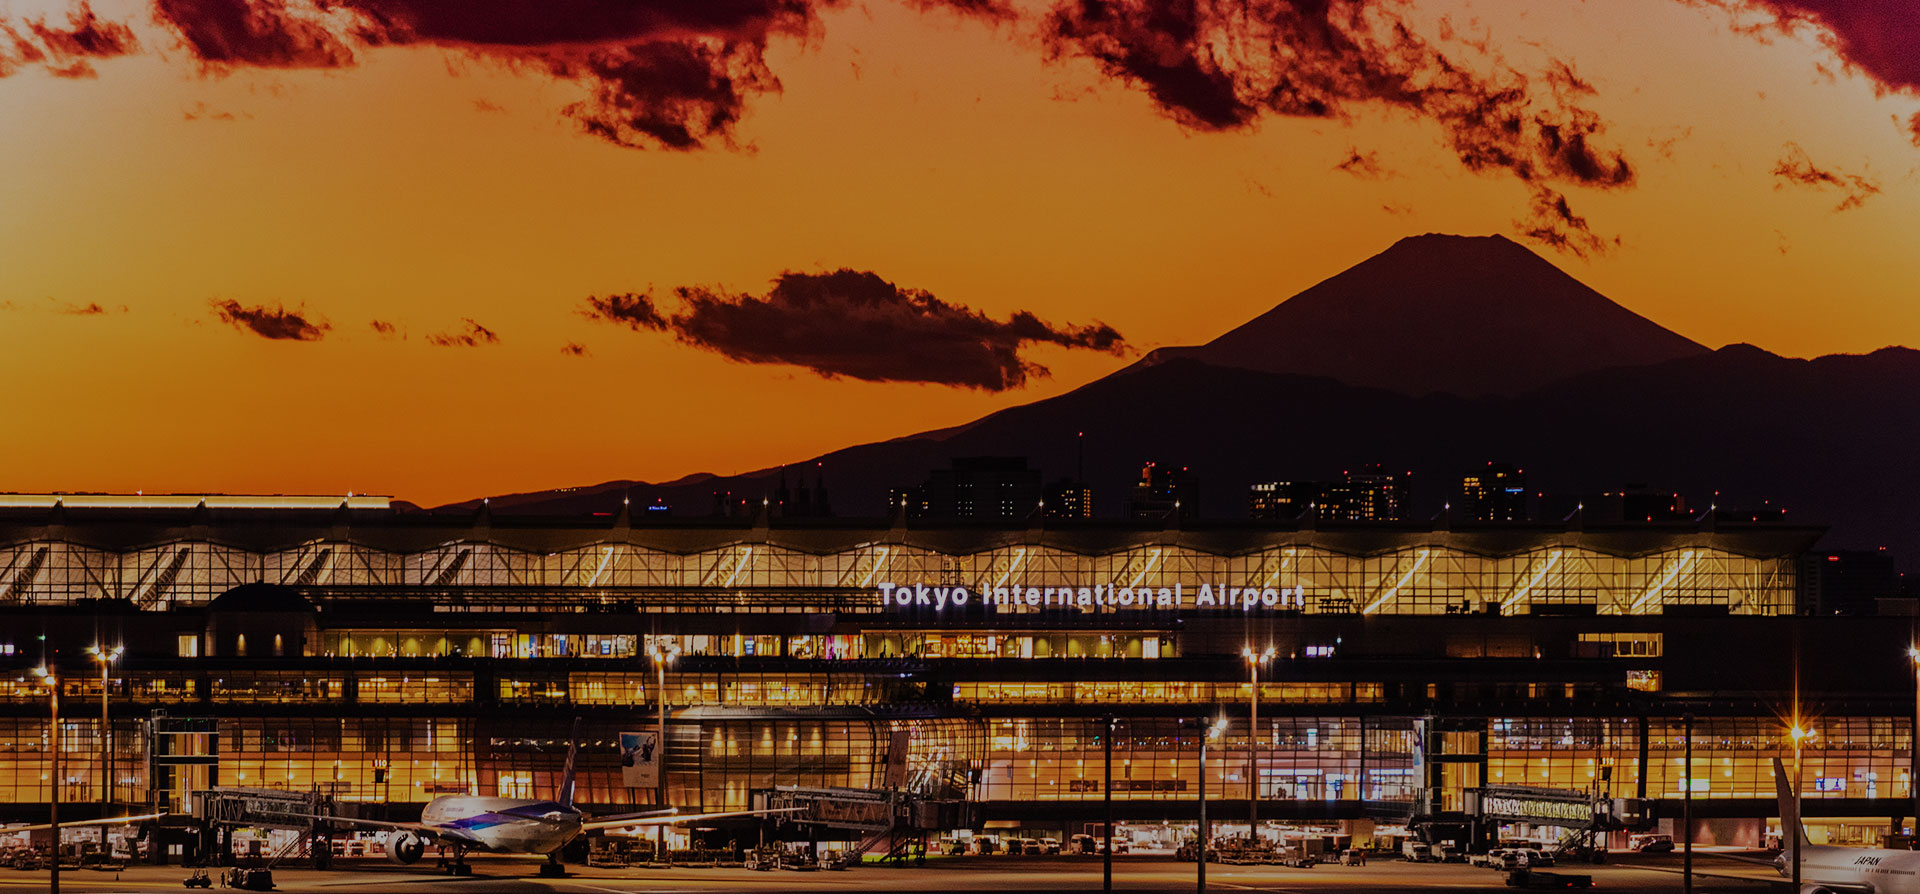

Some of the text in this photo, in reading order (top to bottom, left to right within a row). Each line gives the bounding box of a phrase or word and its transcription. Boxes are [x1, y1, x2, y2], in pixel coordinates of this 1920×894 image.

[877, 582, 1305, 611] Tokyo International Airport
[1854, 856, 1883, 866] JAPAN
